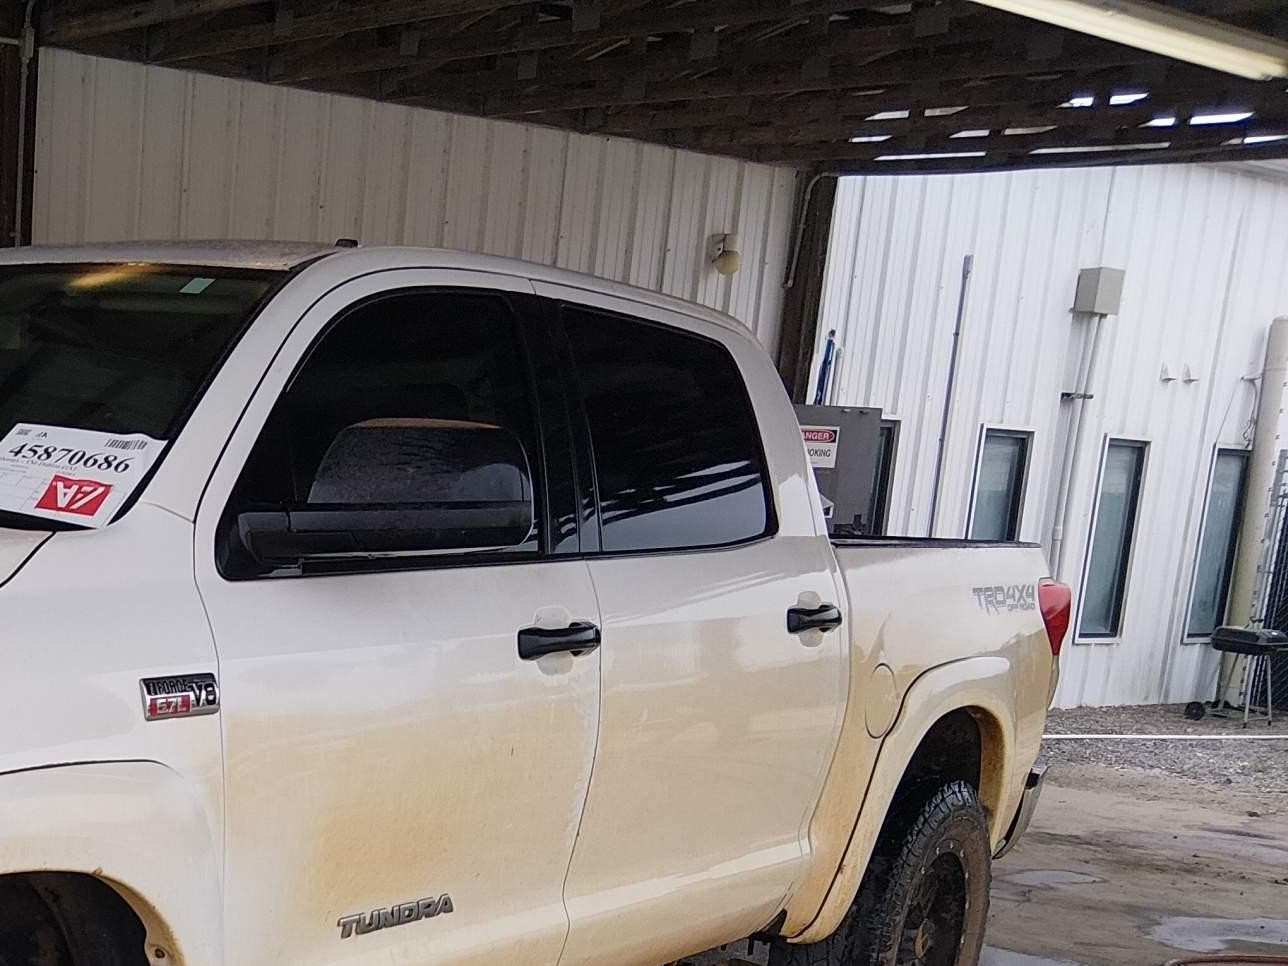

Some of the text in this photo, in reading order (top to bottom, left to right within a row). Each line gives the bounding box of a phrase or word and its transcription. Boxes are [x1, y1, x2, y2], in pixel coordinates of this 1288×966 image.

[802, 431, 830, 440] ANGER
[8, 442, 136, 474] 45870686
[972, 586, 1006, 615] TRD
[191, 682, 217, 707] V8
[337, 893, 454, 939] TUNDRA
